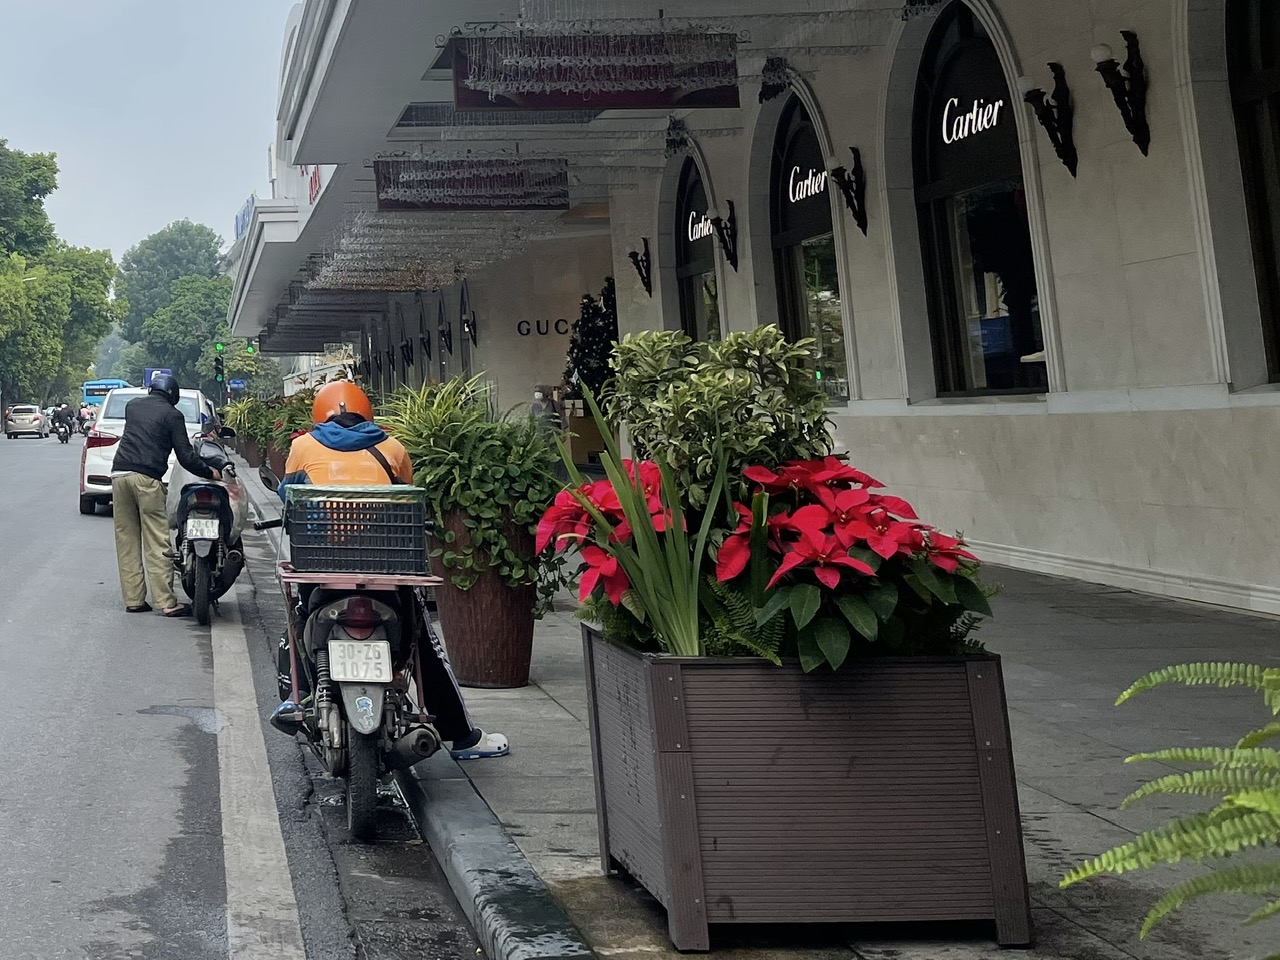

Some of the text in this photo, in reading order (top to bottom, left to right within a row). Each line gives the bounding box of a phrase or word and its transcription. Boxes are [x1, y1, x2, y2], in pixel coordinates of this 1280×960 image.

[942, 97, 1003, 144] Cartier
[789, 165, 828, 203] Cartier
[517, 319, 569, 337] GUC
[338, 644, 382, 661] 30-Z6
[340, 661, 383, 679] 1075
